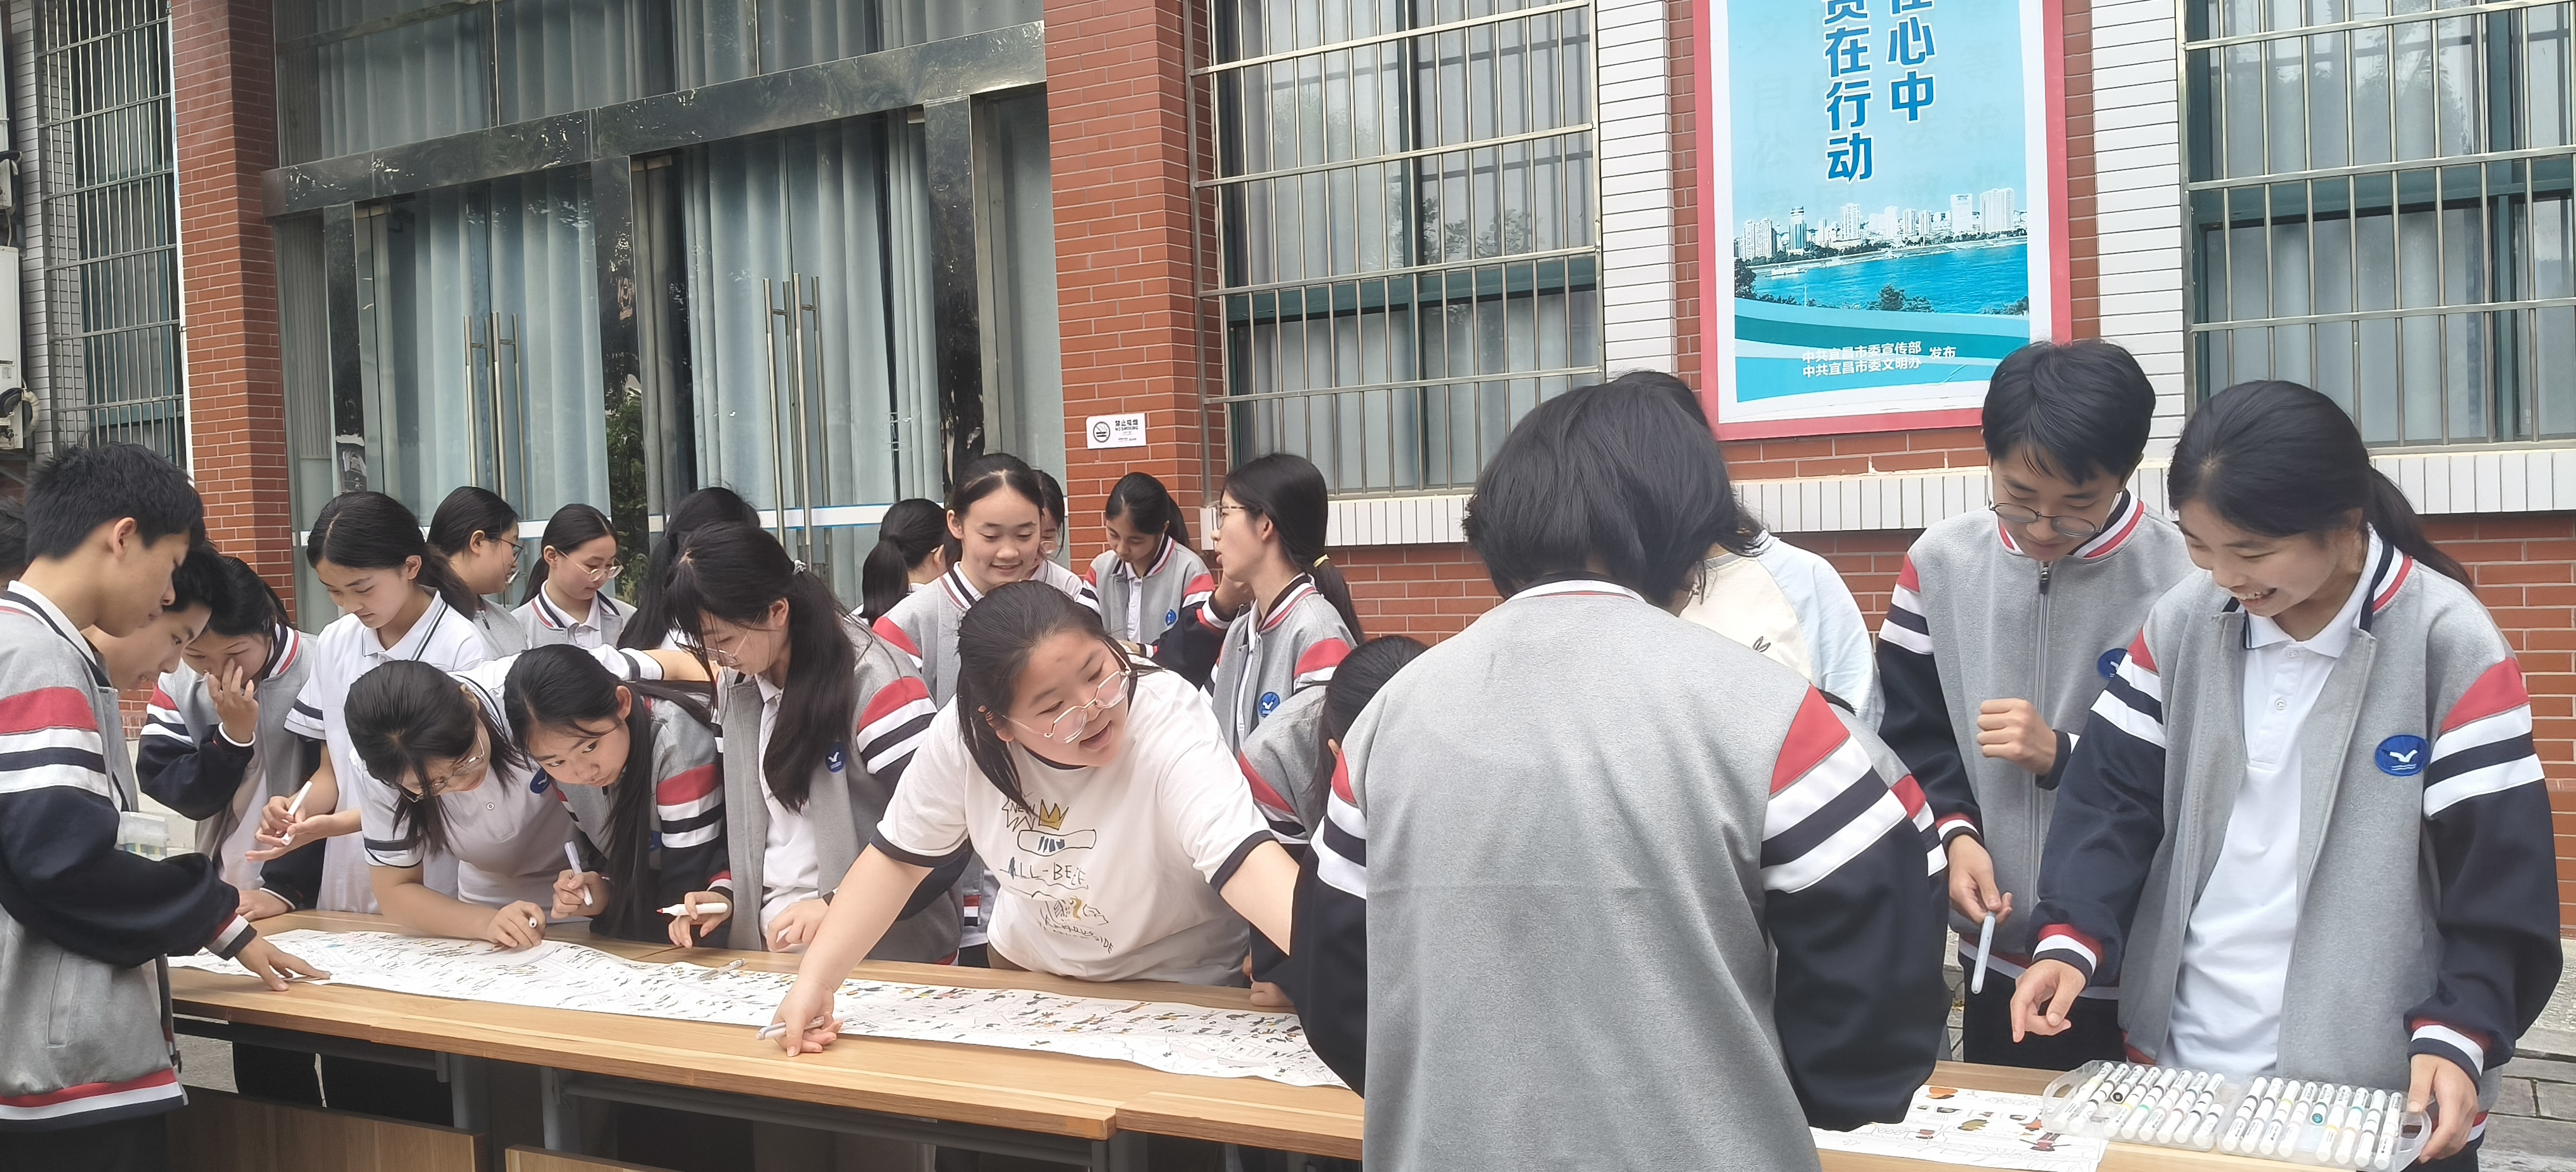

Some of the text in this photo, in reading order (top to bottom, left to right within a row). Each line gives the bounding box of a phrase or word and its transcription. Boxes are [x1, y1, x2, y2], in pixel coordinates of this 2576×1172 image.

[1887, 0, 1935, 121] 心中
[1802, 341, 1921, 363] 中共宜昌市委宣传部
[1929, 346, 1957, 360] 发布
[1802, 357, 1922, 378] 中共宜昌市委文明办
